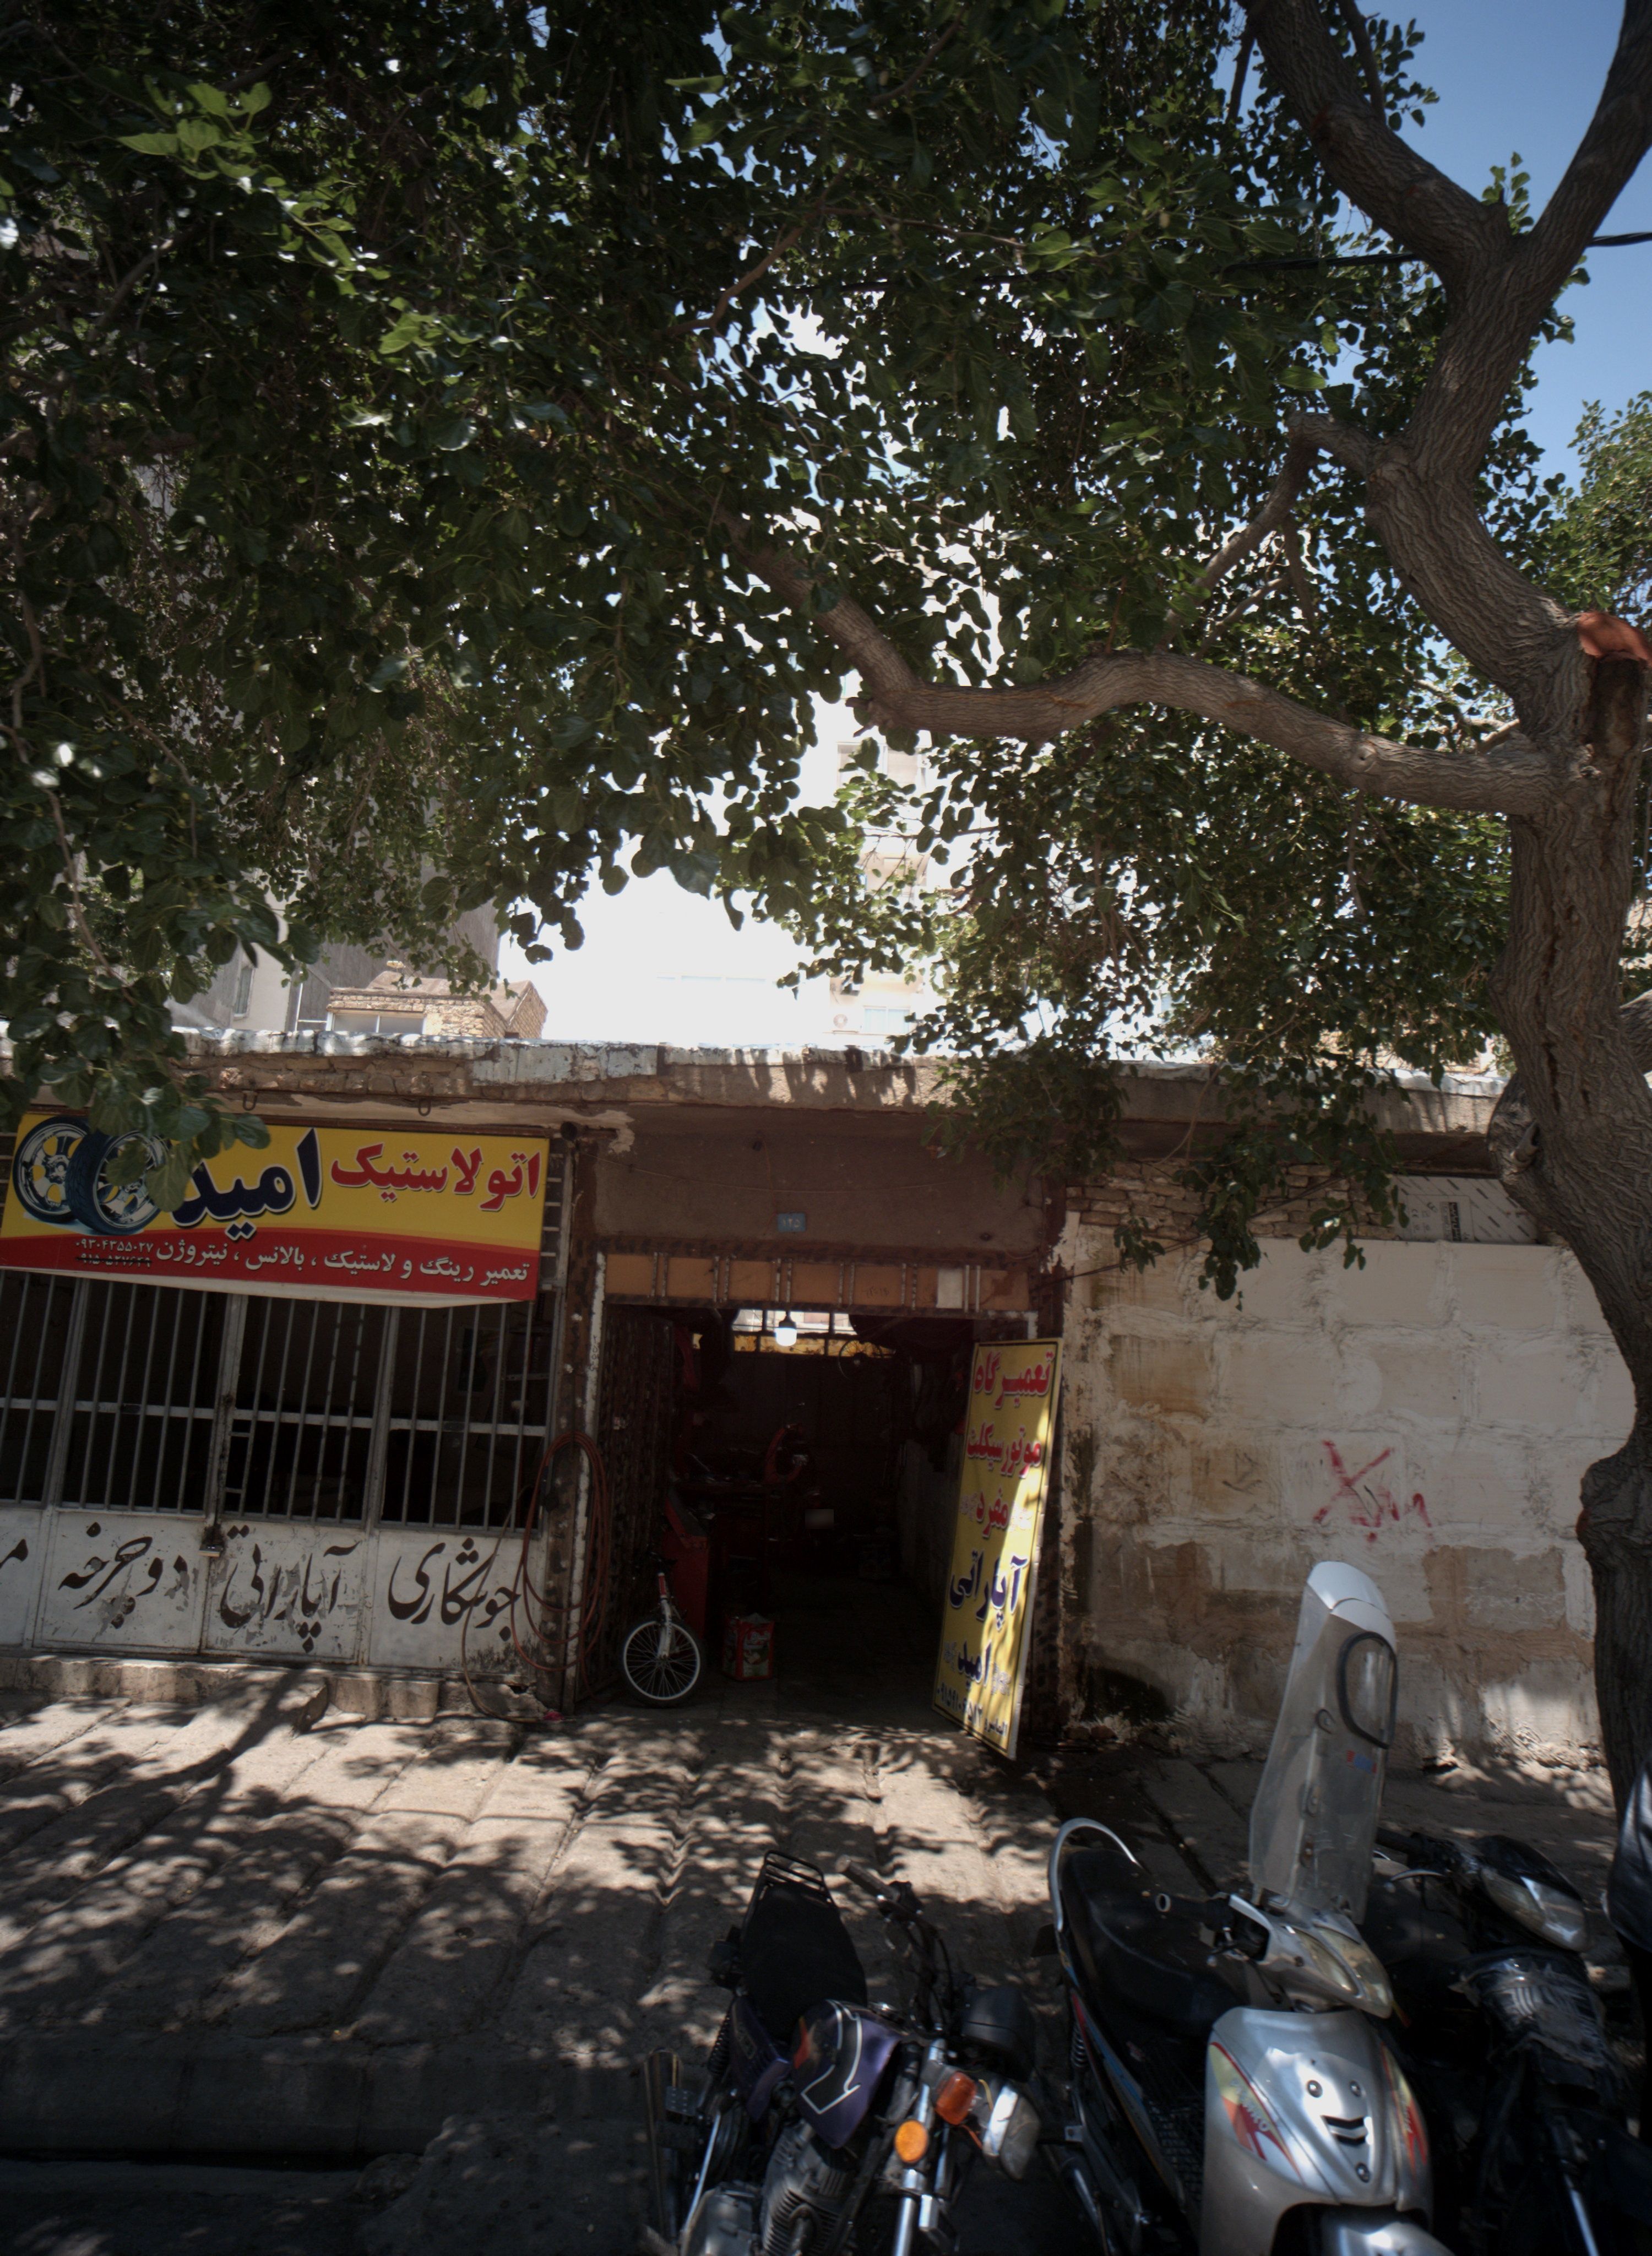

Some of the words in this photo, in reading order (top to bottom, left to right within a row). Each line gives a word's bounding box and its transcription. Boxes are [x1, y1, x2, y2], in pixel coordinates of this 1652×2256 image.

[170, 1127, 322, 1240] امید
[75, 1238, 154, 1253] ۰۹۳۰۴۳۵۵۰۲۷
[156, 1239, 228, 1266] نیتروژن
[245, 1246, 305, 1271] بالانس
[324, 1250, 396, 1275] لاستیک
[400, 1260, 412, 1279] و
[420, 1257, 474, 1282] رینگ
[479, 1262, 530, 1286] تعمیر
[975, 1486, 1009, 1538] مفرد
[388, 1537, 521, 1641] جوشکاری
[949, 1549, 1029, 1632] آپاراتی
[958, 1639, 992, 1690] امید
